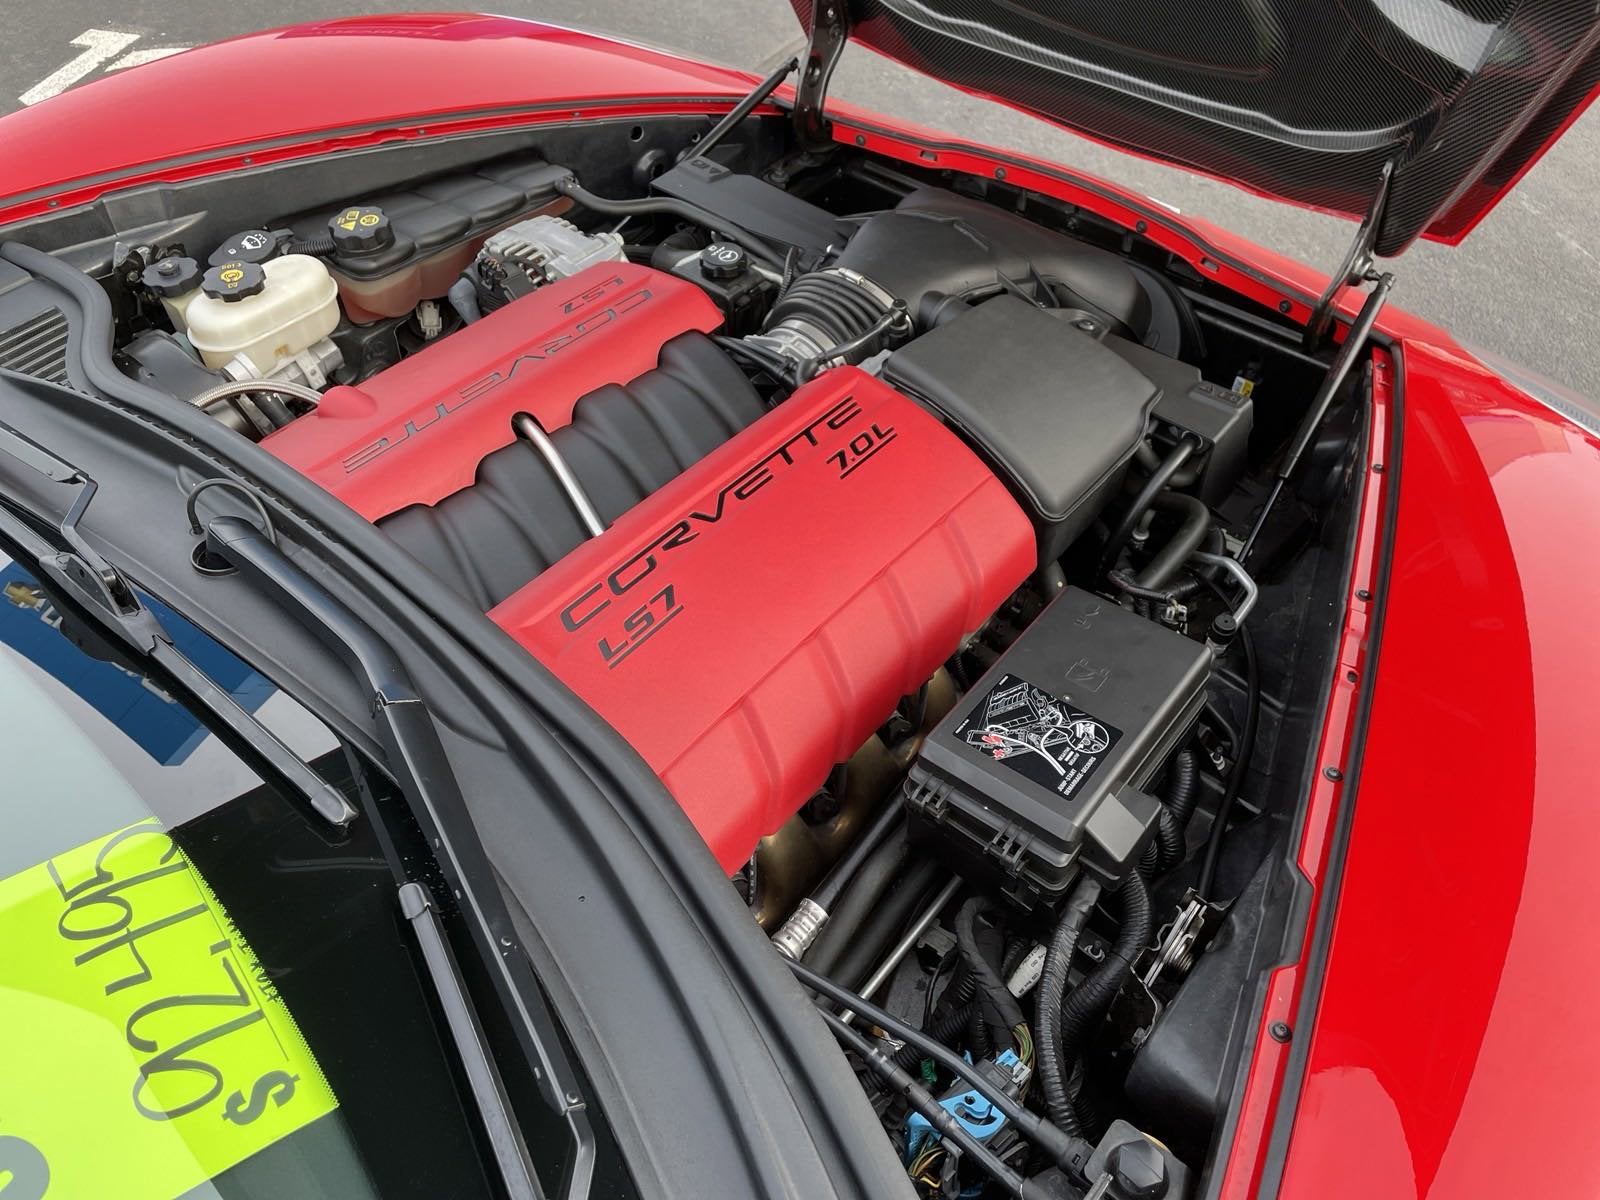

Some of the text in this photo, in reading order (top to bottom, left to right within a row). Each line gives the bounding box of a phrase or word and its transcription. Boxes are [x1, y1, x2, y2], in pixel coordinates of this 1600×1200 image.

[564, 277, 624, 314] LS7
[342, 289, 653, 475] CORVETTE
[826, 423, 895, 471] 7.0L
[560, 396, 862, 633] CORVETTE
[598, 584, 676, 662] LS7
